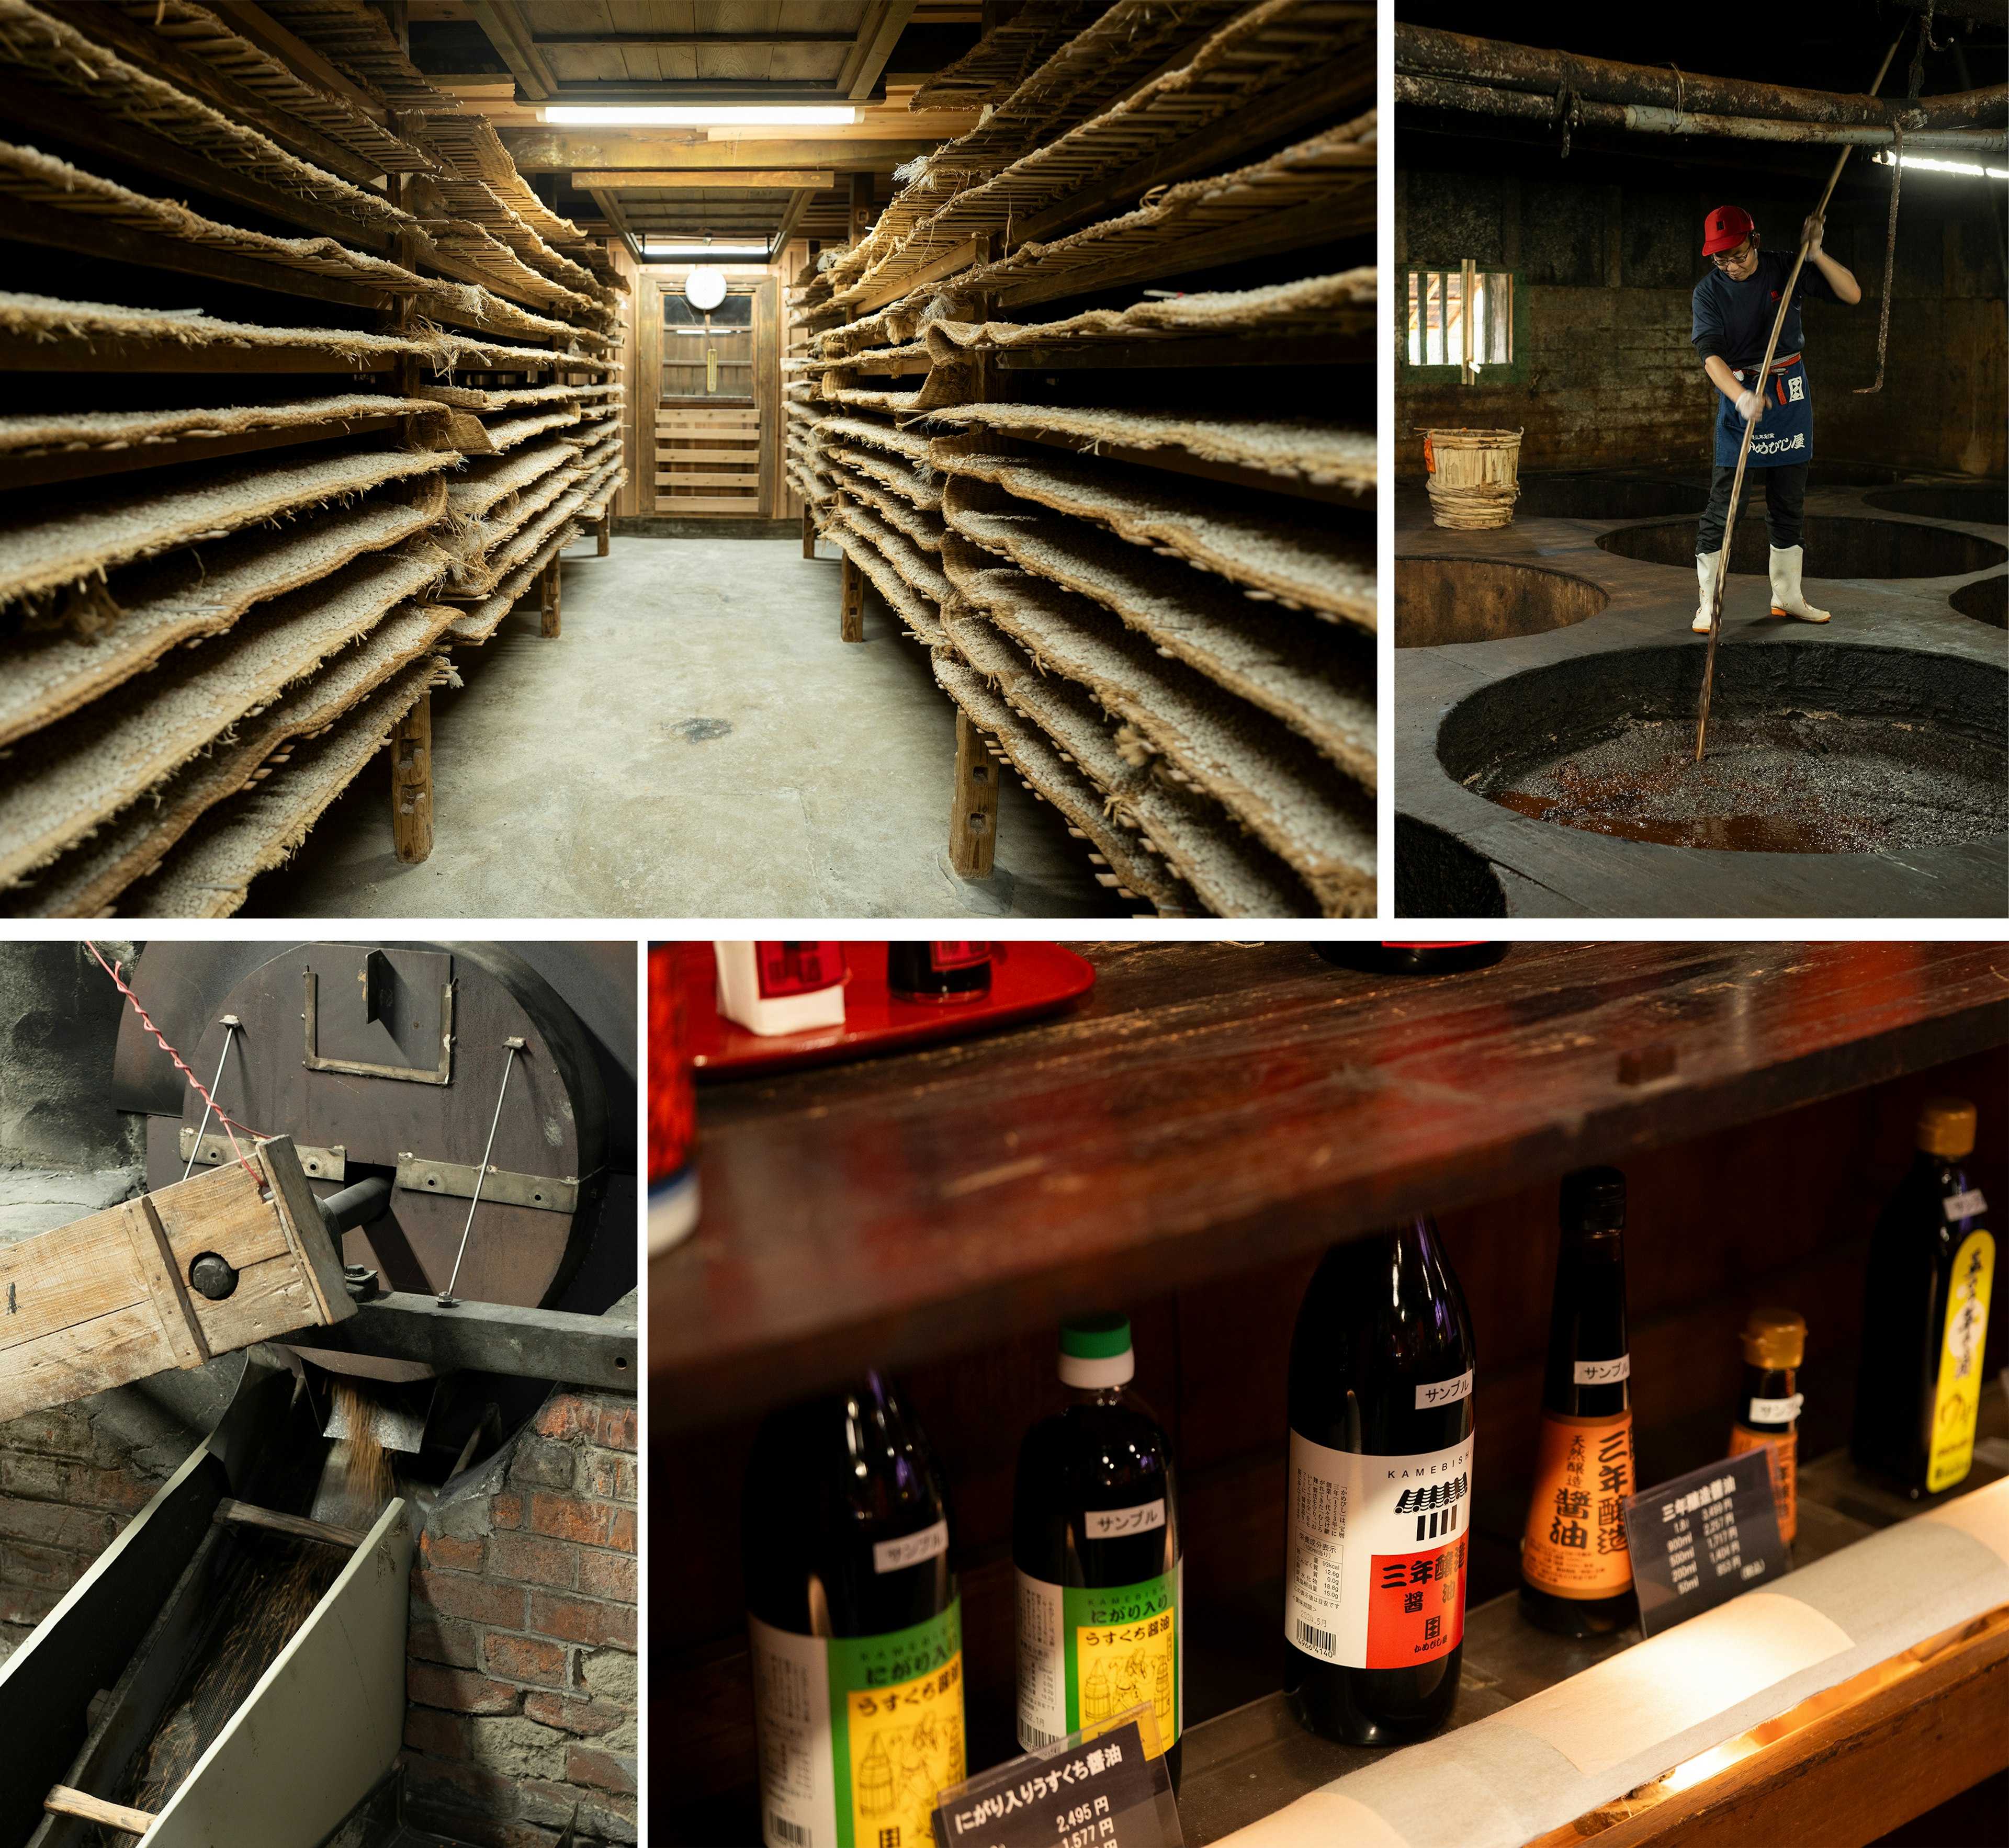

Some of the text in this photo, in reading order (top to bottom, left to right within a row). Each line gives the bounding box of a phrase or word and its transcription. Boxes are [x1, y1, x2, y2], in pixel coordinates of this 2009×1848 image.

[1584, 1362, 1629, 1380] サンプル
[1425, 1379, 1469, 1403] サンプル
[1388, 1447, 1472, 1479] KAMEBISHI
[1098, 1510, 1158, 1533] サンプル
[1666, 1530, 1693, 1554] 900ml
[1322, 1561, 1340, 1570] 93kcal
[1325, 1569, 1339, 1579] 12.6g
[1381, 1540, 1466, 1589] 三年醸造
[1324, 1583, 1339, 1593] 18.8g
[1327, 1577, 1339, 1585] 0.0g
[1324, 1590, 1338, 1600] 15.0g
[1091, 1593, 1168, 1624] にがり入り
[1086, 1615, 1170, 1646] うすくち醤油
[1298, 1637, 1333, 1658] 4966 4140
[955, 1743, 1123, 1835] にがり入りうすくち醤油
[1056, 1795, 1110, 1833] 2,495 円
[1099, 1817, 1114, 1838] 円
